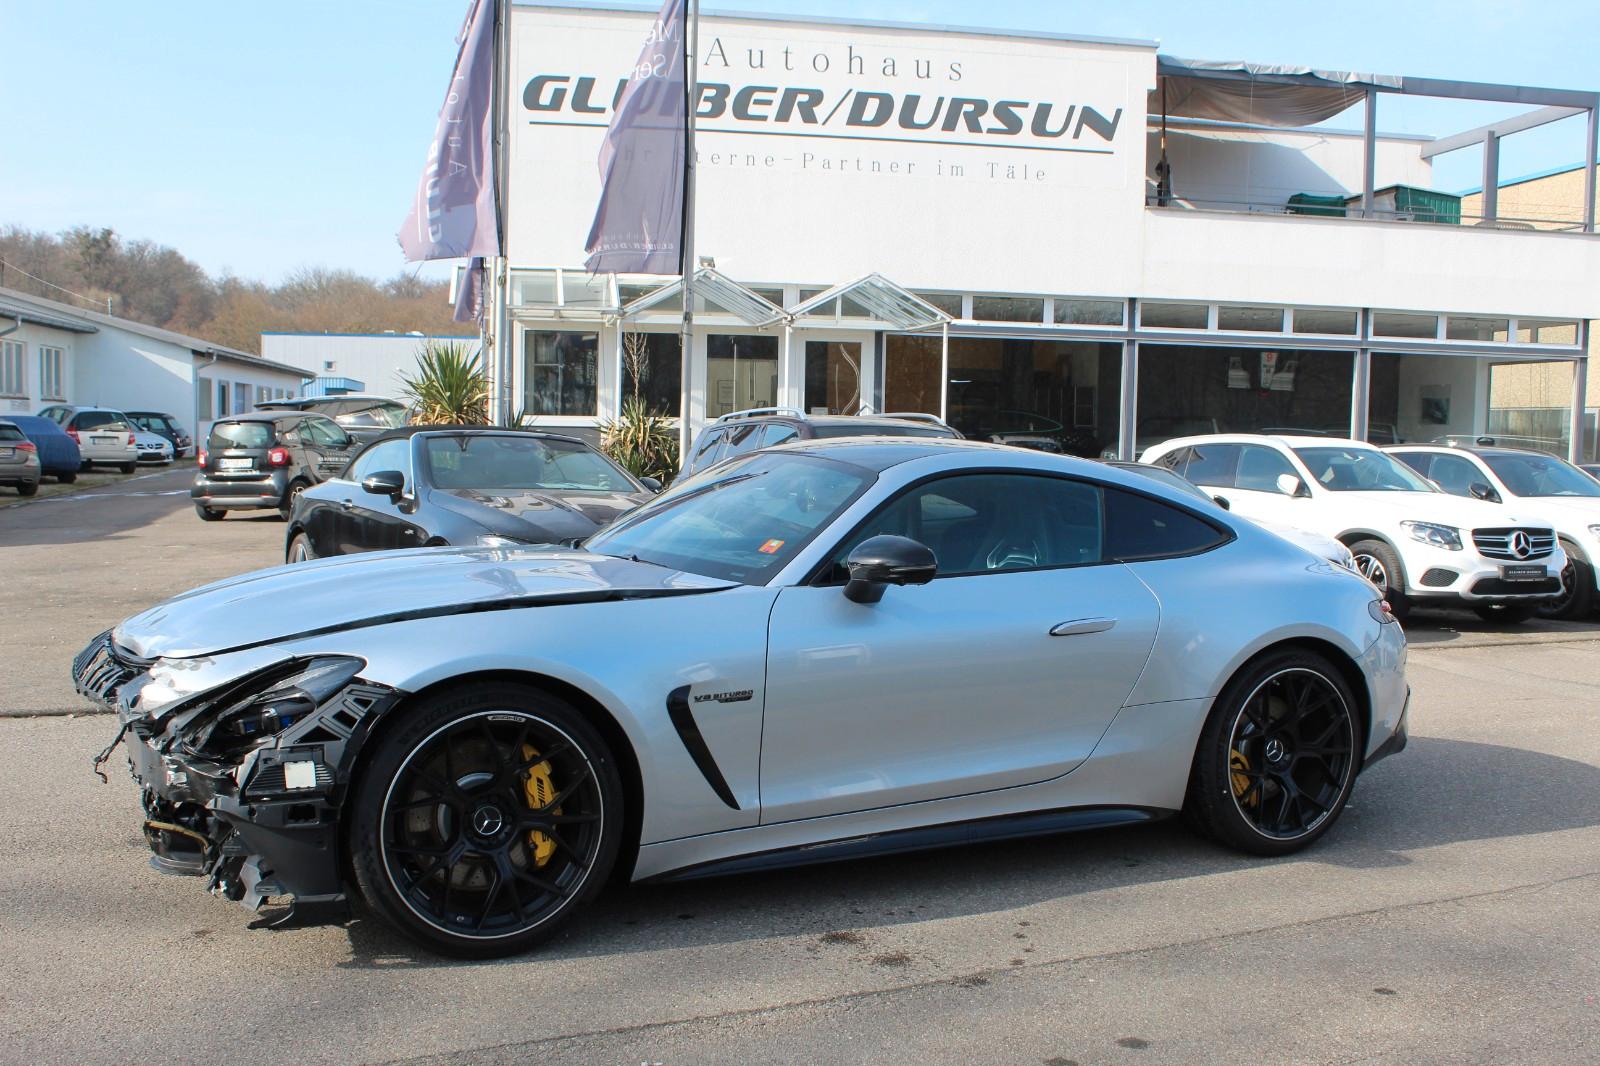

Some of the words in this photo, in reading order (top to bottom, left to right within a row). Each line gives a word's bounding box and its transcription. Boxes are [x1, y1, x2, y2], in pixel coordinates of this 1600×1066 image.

[703, 36, 962, 81] Autohaus
[694, 148, 916, 175] terne-Partner
[936, 159, 965, 177] im
[986, 161, 1046, 181] Täle
[713, 689, 754, 700] BITURBO
